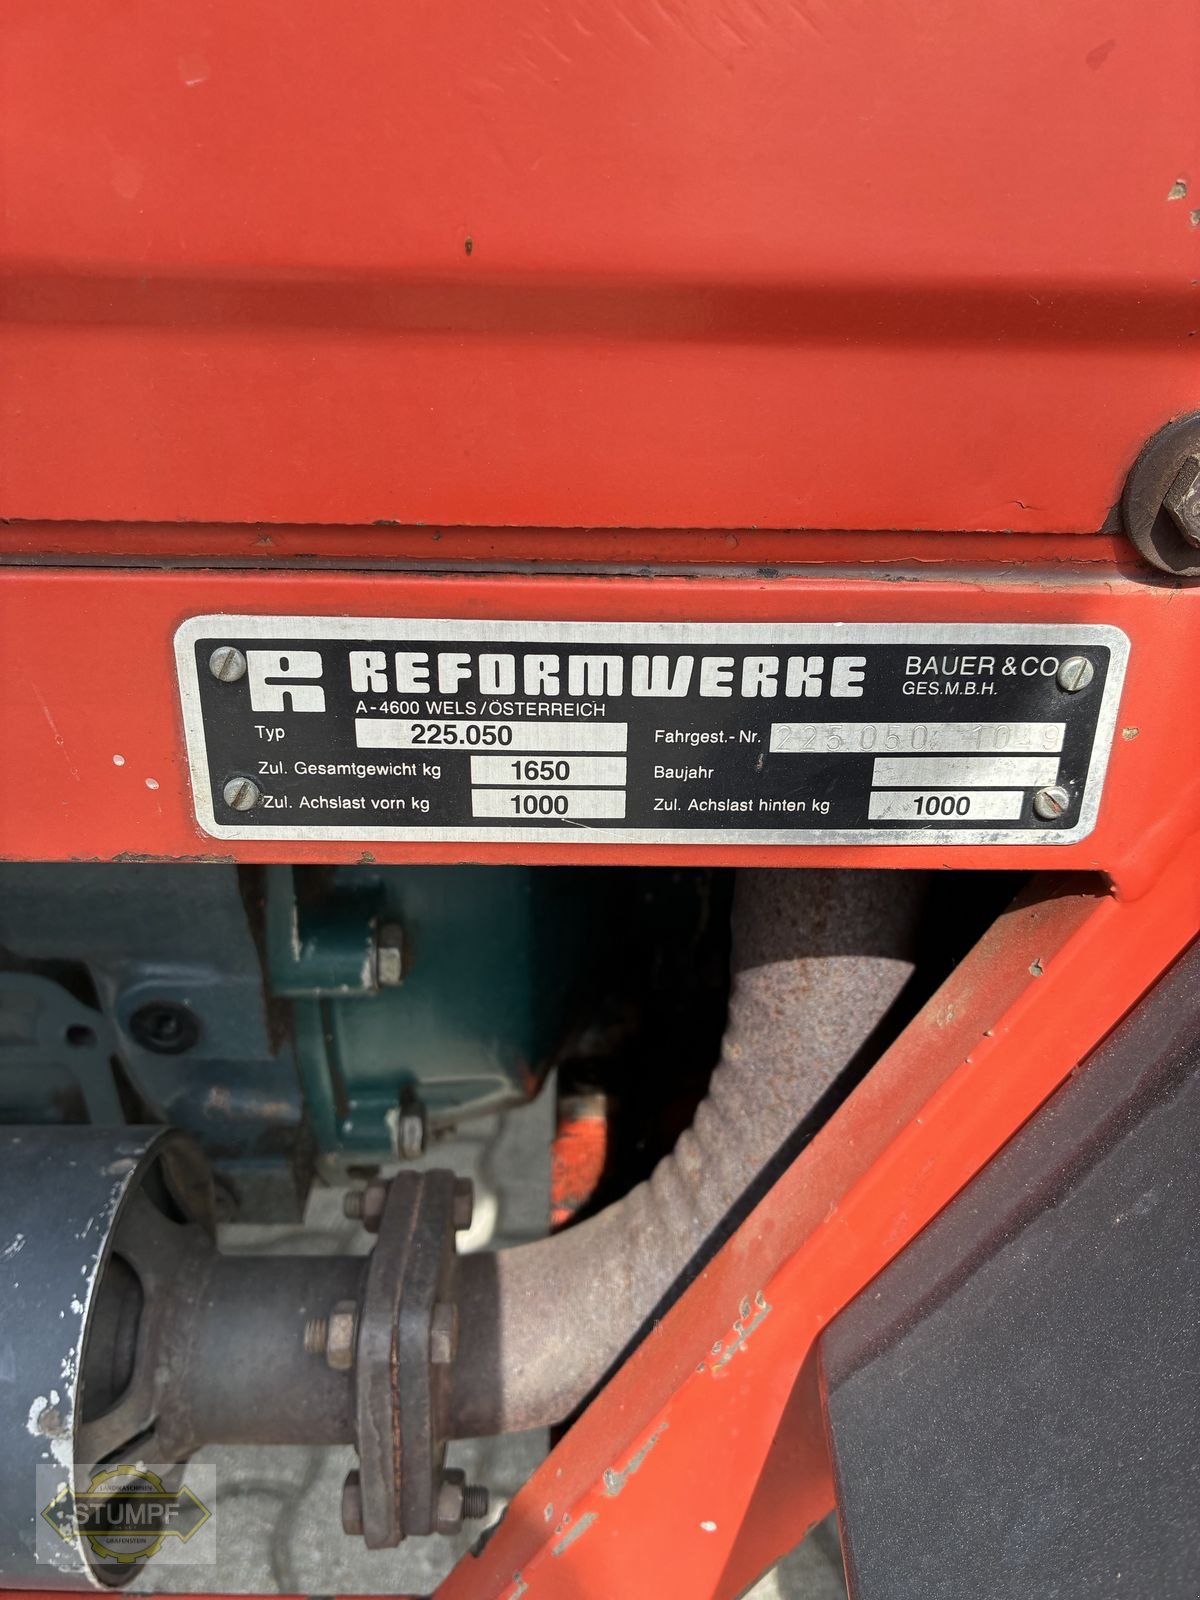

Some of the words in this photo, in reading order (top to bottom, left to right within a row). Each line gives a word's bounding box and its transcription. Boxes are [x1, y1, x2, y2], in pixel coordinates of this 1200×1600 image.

[349, 650, 867, 698] REFORMWERKE
[905, 656, 995, 676] BAUER
[902, 681, 998, 696] GES.M.B.H.
[254, 725, 286, 742] Typ
[410, 723, 514, 747] 225.050
[258, 761, 289, 775] Zul.
[294, 761, 418, 779] Gesamtgewicht
[422, 764, 442, 779] kg
[511, 760, 570, 781] 1650
[653, 766, 714, 781] Baujahr
[263, 796, 294, 810] Zul.
[299, 795, 366, 811] Achslast
[371, 799, 406, 811] vorn
[411, 797, 431, 813] kg
[511, 795, 569, 815] 1000
[653, 799, 683, 812] Zul.
[687, 798, 754, 812] Achslast
[758, 798, 806, 812] hinten
[811, 800, 831, 815] kg
[913, 796, 971, 817] 1000
